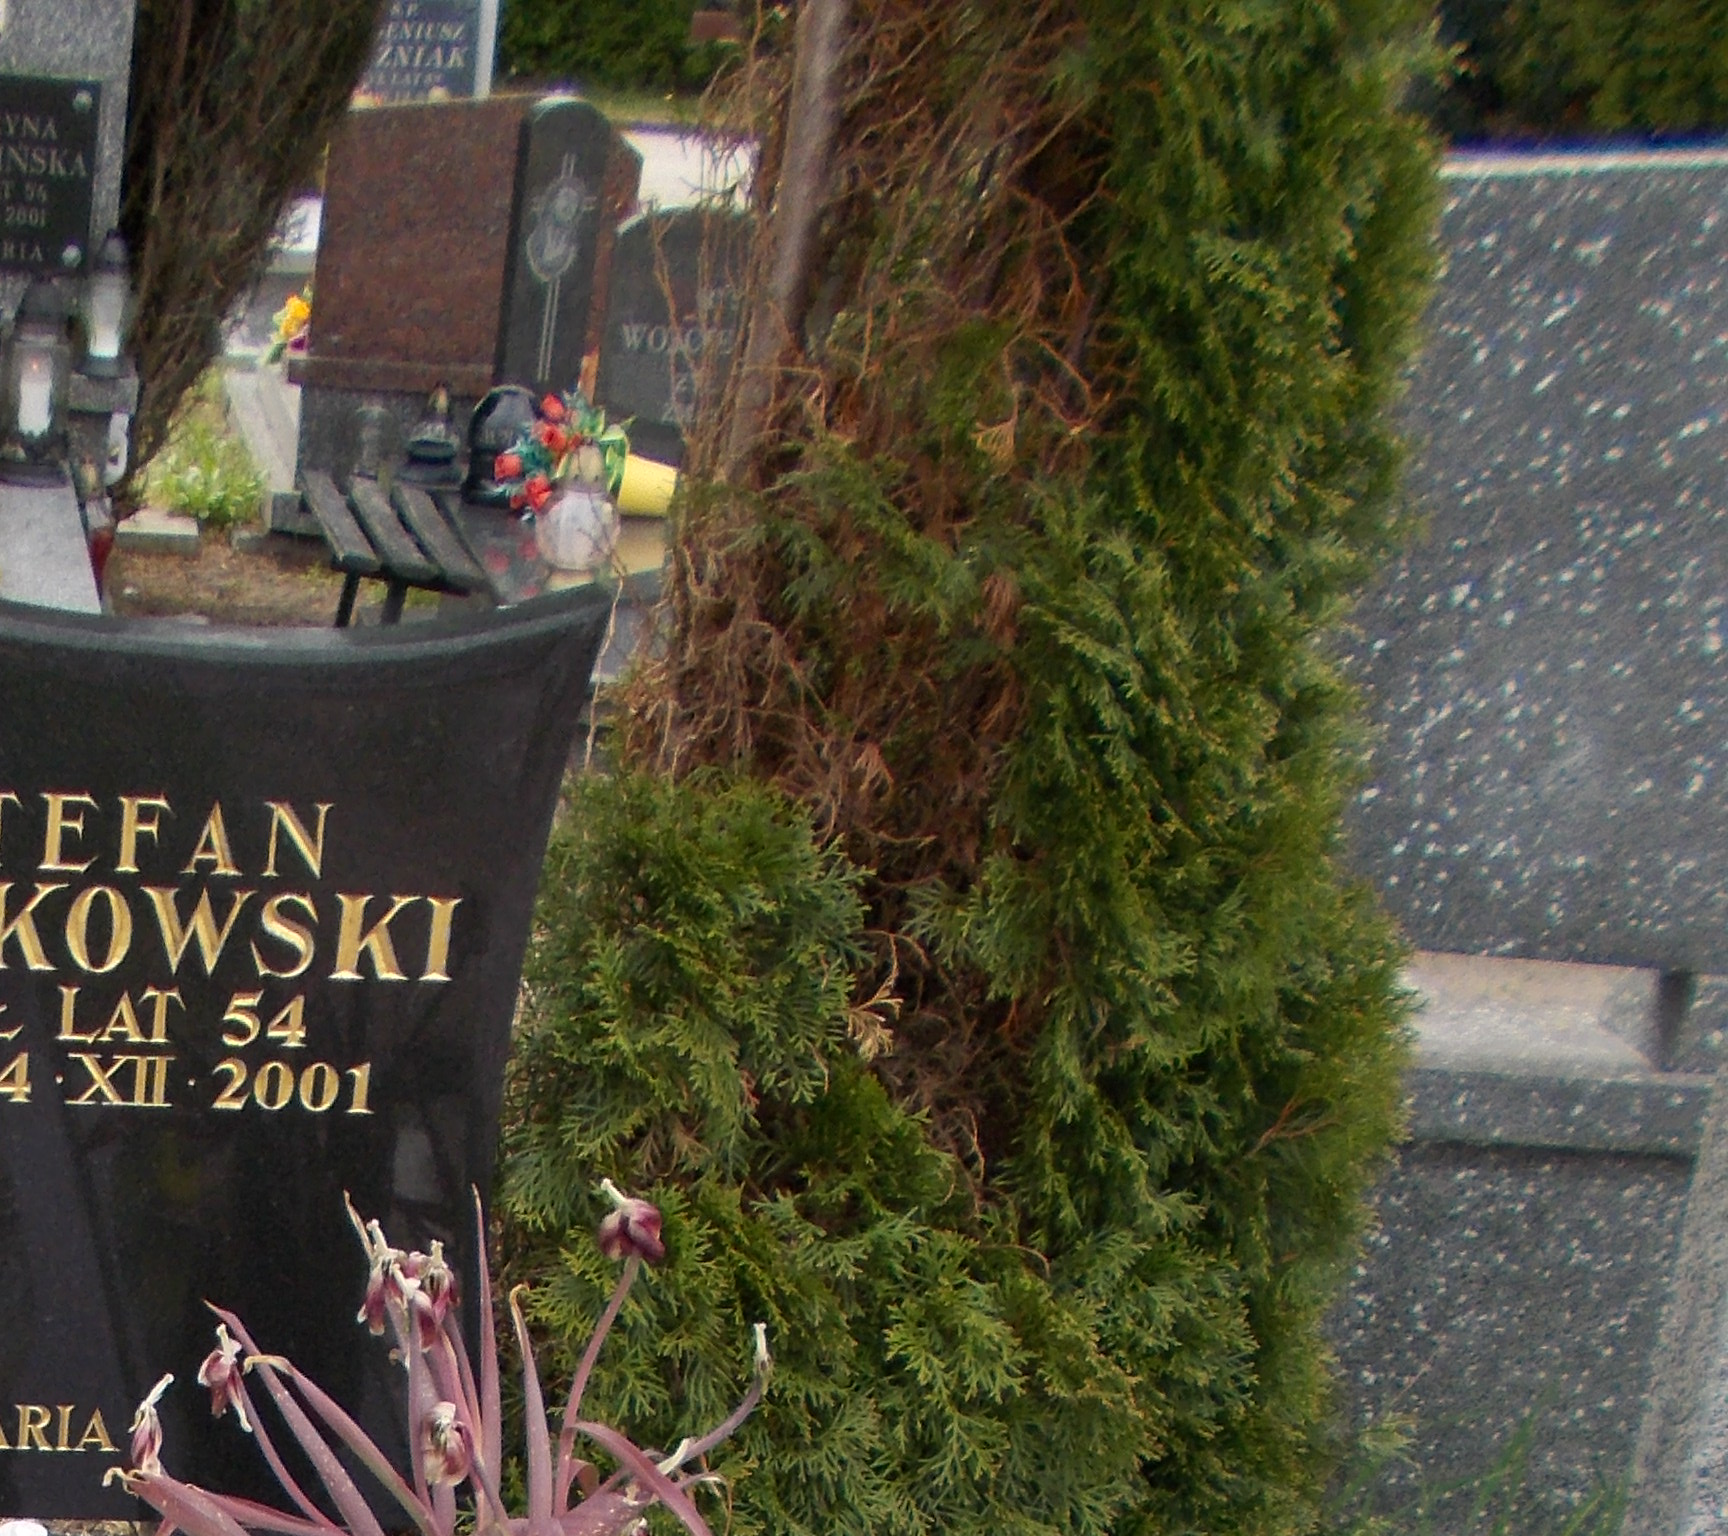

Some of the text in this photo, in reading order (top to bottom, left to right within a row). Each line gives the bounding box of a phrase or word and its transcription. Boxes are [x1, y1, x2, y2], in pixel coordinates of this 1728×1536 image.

[376, 46, 469, 69] ZNIAK
[58, 985, 184, 1044] LAT
[221, 989, 307, 1048] 54
